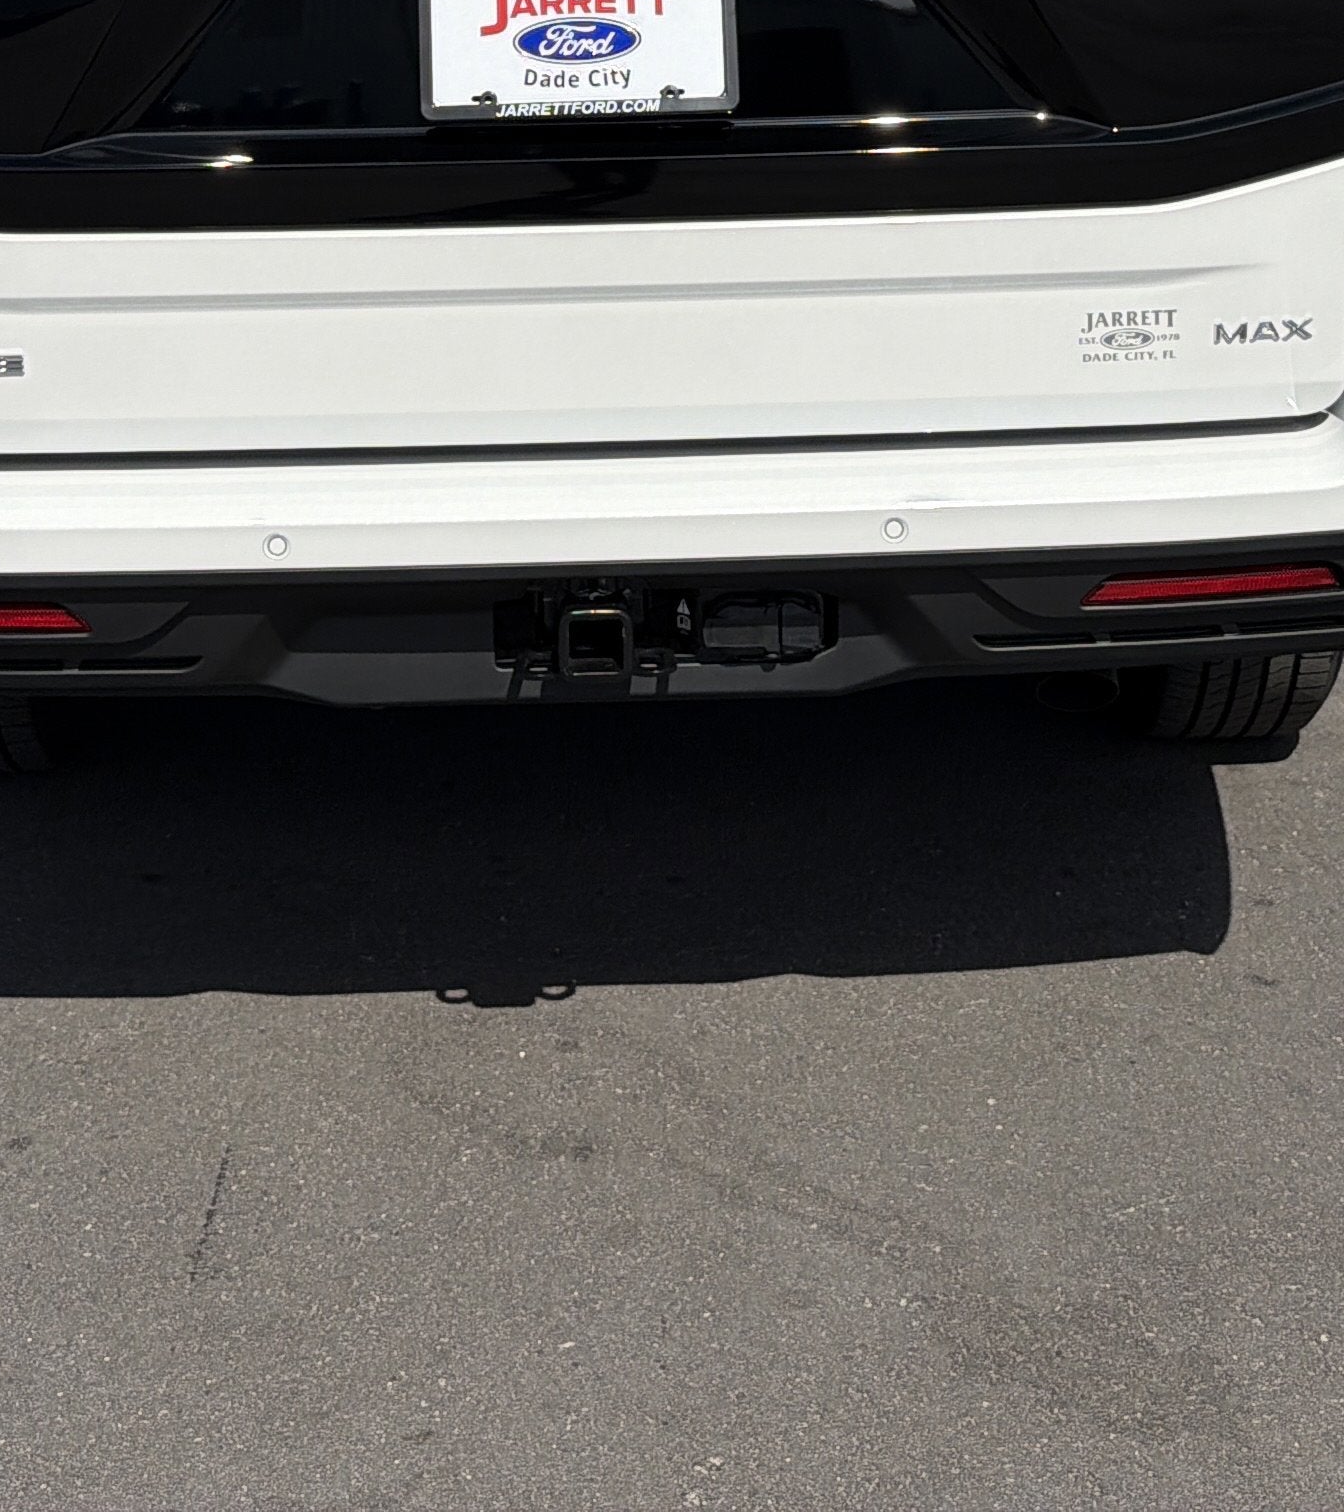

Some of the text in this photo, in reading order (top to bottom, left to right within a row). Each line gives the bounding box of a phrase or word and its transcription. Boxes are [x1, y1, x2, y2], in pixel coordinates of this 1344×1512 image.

[538, 24, 616, 56] Ford
[523, 68, 632, 89] Dade City
[495, 98, 661, 118] JARRETTFORD.COM
[1080, 308, 1178, 334] JARRETT
[1212, 317, 1314, 345] MAX
[1078, 332, 1181, 347] EST. Ford 1978
[1082, 352, 1120, 363] DADE
[1162, 349, 1177, 360] FL
